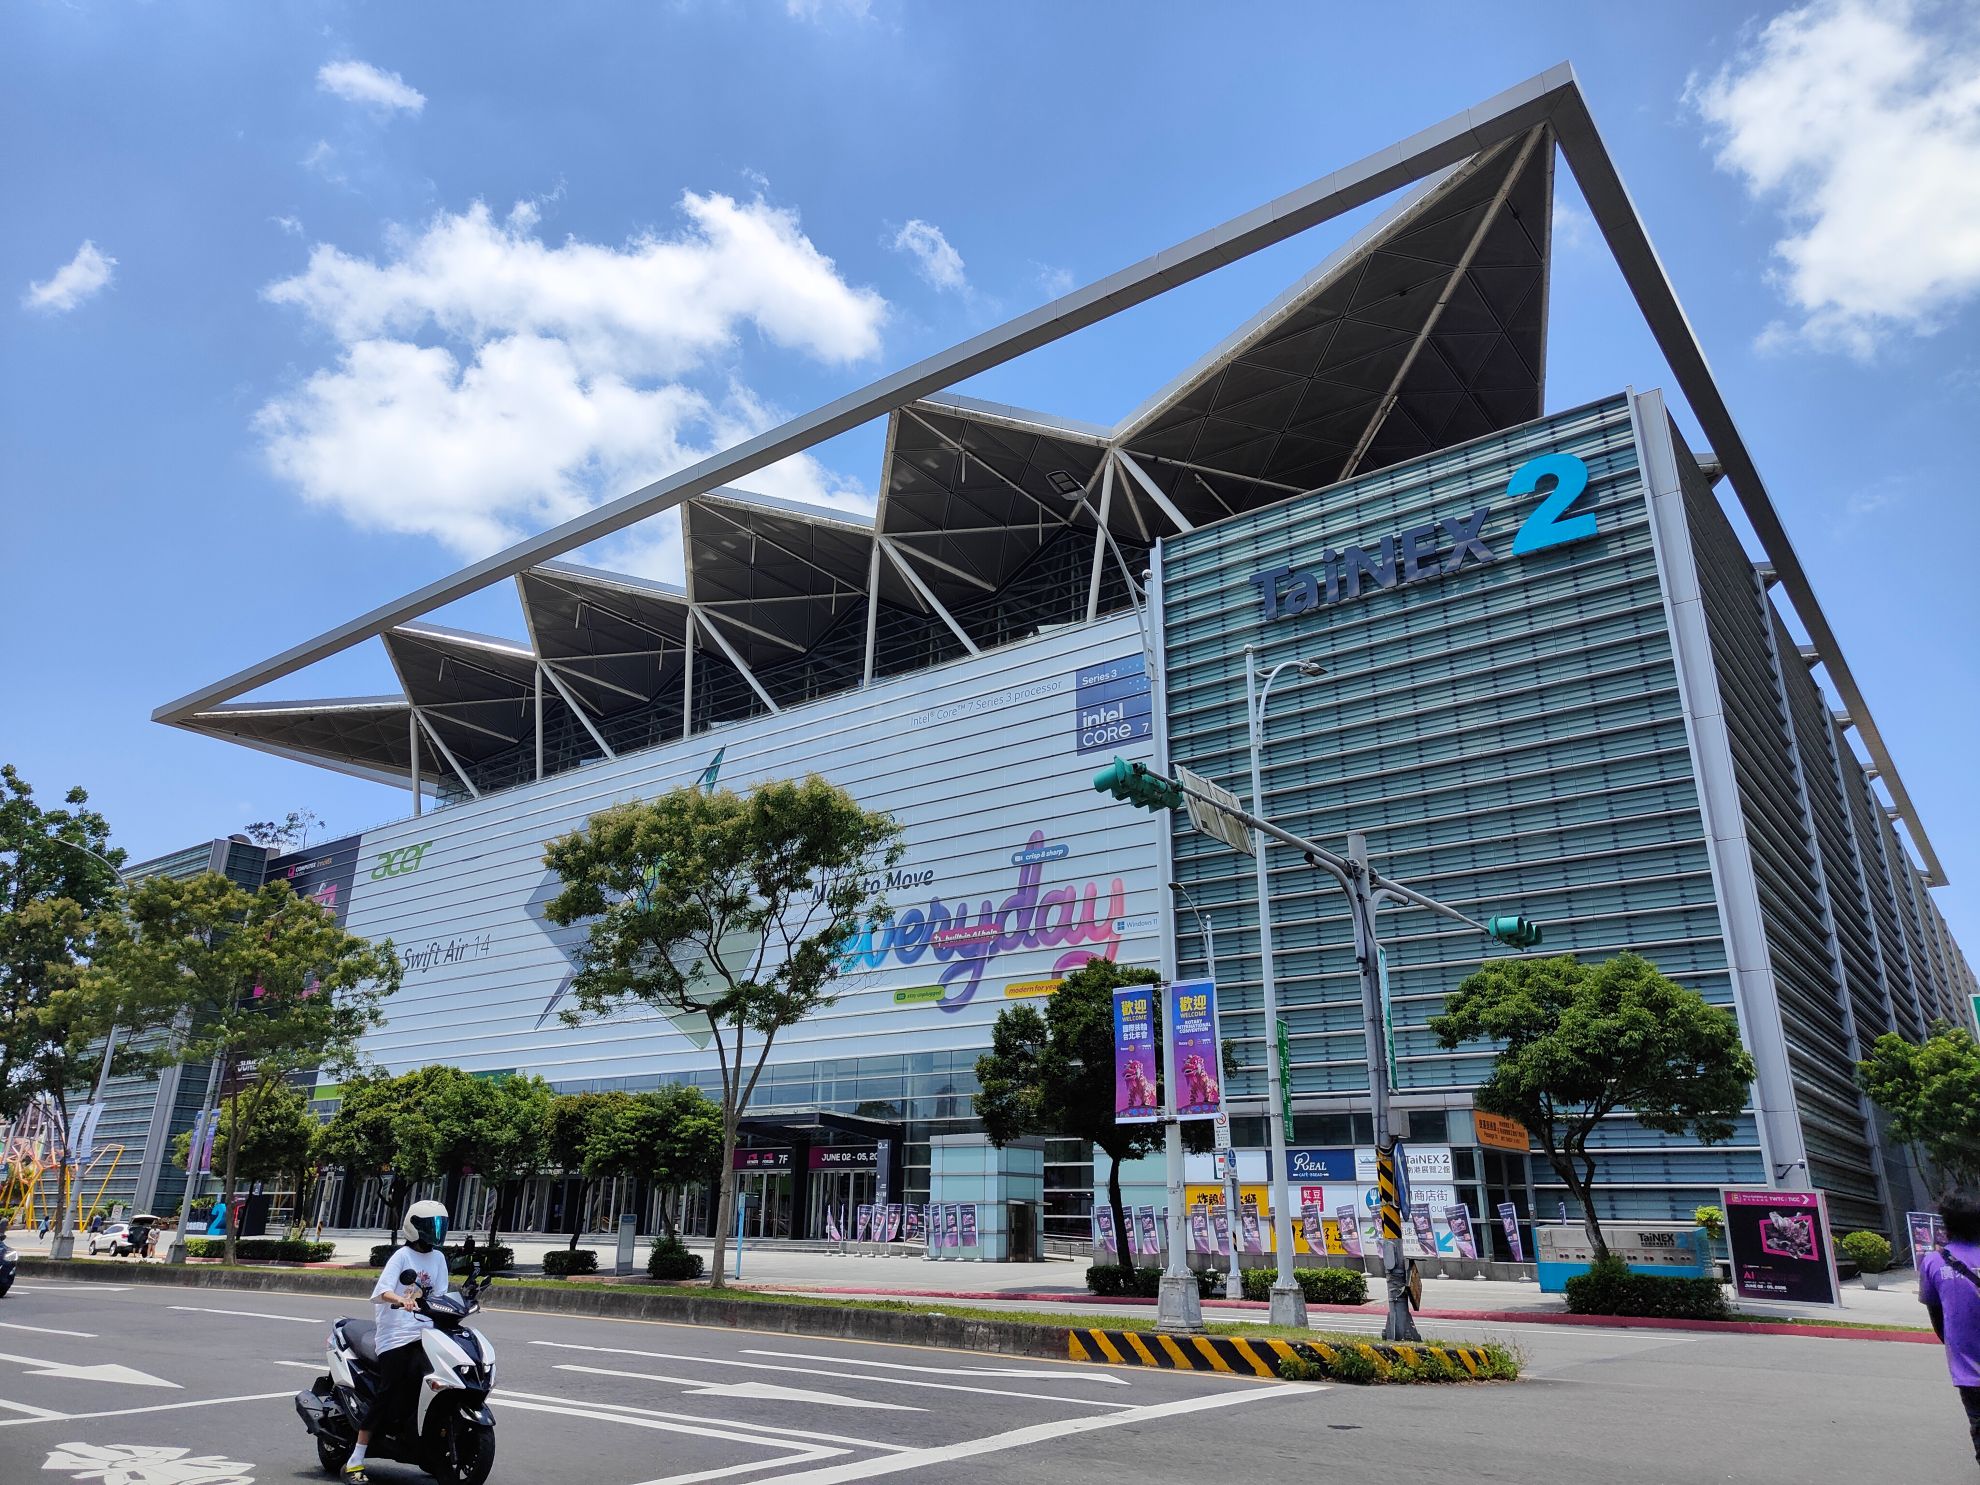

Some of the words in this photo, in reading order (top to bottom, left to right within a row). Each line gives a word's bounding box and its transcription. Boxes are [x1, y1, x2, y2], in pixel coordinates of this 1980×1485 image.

[1249, 506, 1498, 621] TaiNEX
[1506, 453, 1598, 556] 2
[1082, 673, 1109, 686] Series
[1111, 669, 1118, 678] 3
[967, 701, 974, 712] 7
[975, 696, 1004, 710] Series
[1005, 691, 1013, 703] 3
[1014, 680, 1063, 703] processor
[1082, 702, 1124, 731] intel
[1142, 723, 1149, 734] 7
[1025, 852, 1041, 861] crisp
[1046, 849, 1064, 858] sharp
[370, 842, 434, 880] acer
[862, 877, 881, 895] to
[885, 869, 935, 893] Move
[1126, 920, 1152, 928] Windows
[1153, 917, 1158, 925] 11
[403, 941, 440, 973] Swift
[443, 937, 469, 965] Air
[474, 933, 492, 958] 14
[1008, 985, 1034, 995] modern
[1034, 984, 1045, 992] for
[1121, 999, 1148, 1017] 歡迎
[1179, 994, 1207, 1013] 歡迎
[1122, 1014, 1148, 1023] WELCOME
[1180, 1010, 1207, 1019] WELCOME
[1176, 1022, 1212, 1031] INTERNATIONAL
[1179, 1026, 1209, 1034] CONVENTION
[1123, 1031, 1148, 1041] 台北年會
[778, 1154, 789, 1165] 7F
[821, 1153, 841, 1162] JUNE
[841, 1152, 851, 1161] 02
[856, 1152, 869, 1162] 05,
[1294, 1152, 1327, 1171] REAL
[1406, 1154, 1440, 1165] TaiNEX
[1441, 1153, 1450, 1164] 2
[1303, 1189, 1322, 1199] 紅豆
[1410, 1189, 1448, 1202] 商店街
[1637, 1232, 1675, 1242] TaiNEX
[1743, 1271, 1755, 1280] AI
